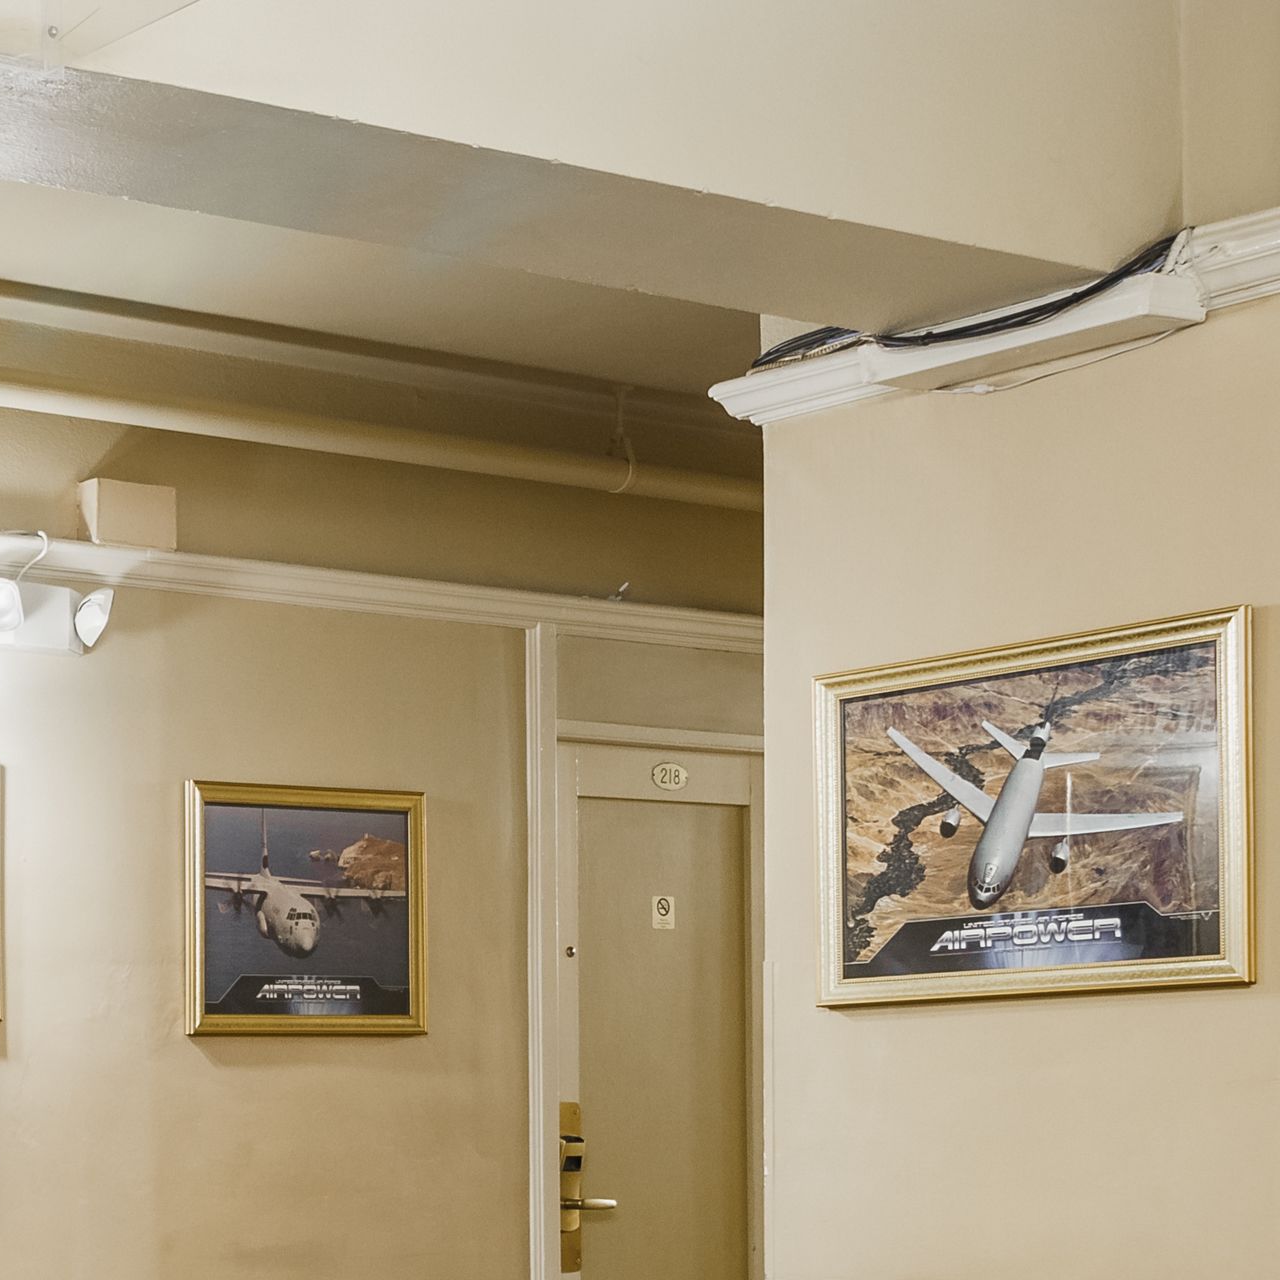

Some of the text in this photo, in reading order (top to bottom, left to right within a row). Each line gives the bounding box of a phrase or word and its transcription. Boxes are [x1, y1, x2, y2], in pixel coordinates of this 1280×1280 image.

[659, 767, 681, 786] 218
[929, 917, 1122, 952] AIRPOWER
[256, 984, 361, 999] AIRPOWER
